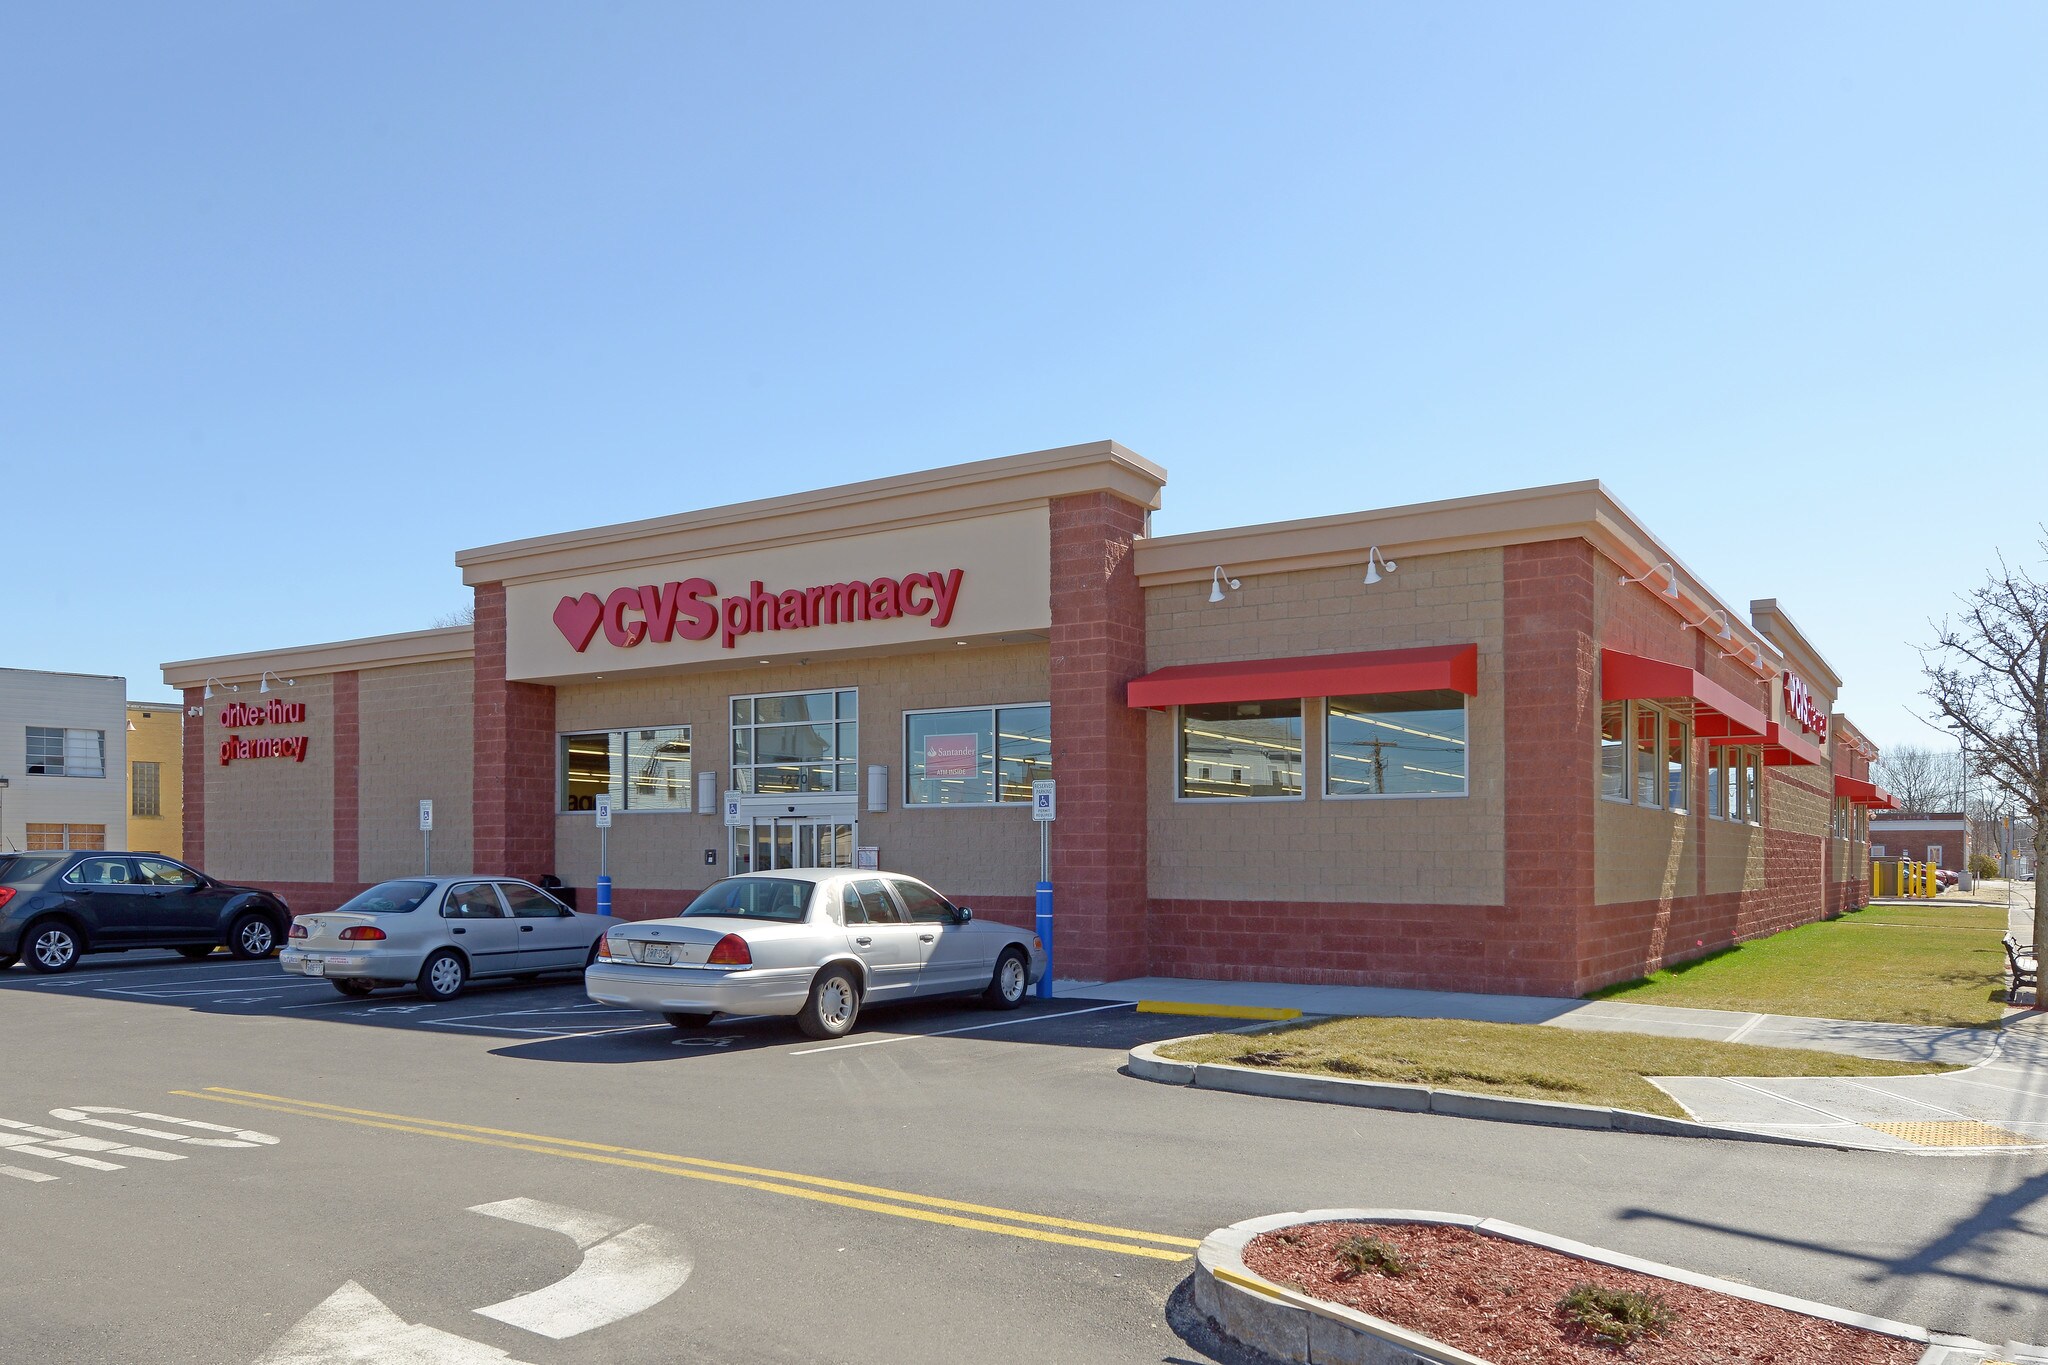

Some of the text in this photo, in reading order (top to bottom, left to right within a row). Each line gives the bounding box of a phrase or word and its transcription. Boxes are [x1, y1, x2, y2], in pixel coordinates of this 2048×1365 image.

[603, 568, 964, 649] CVS pharmacy
[219, 698, 305, 728] drive-thru
[219, 735, 308, 766] pharmacy
[937, 746, 975, 757] Santander
[780, 774, 807, 785] 1270
